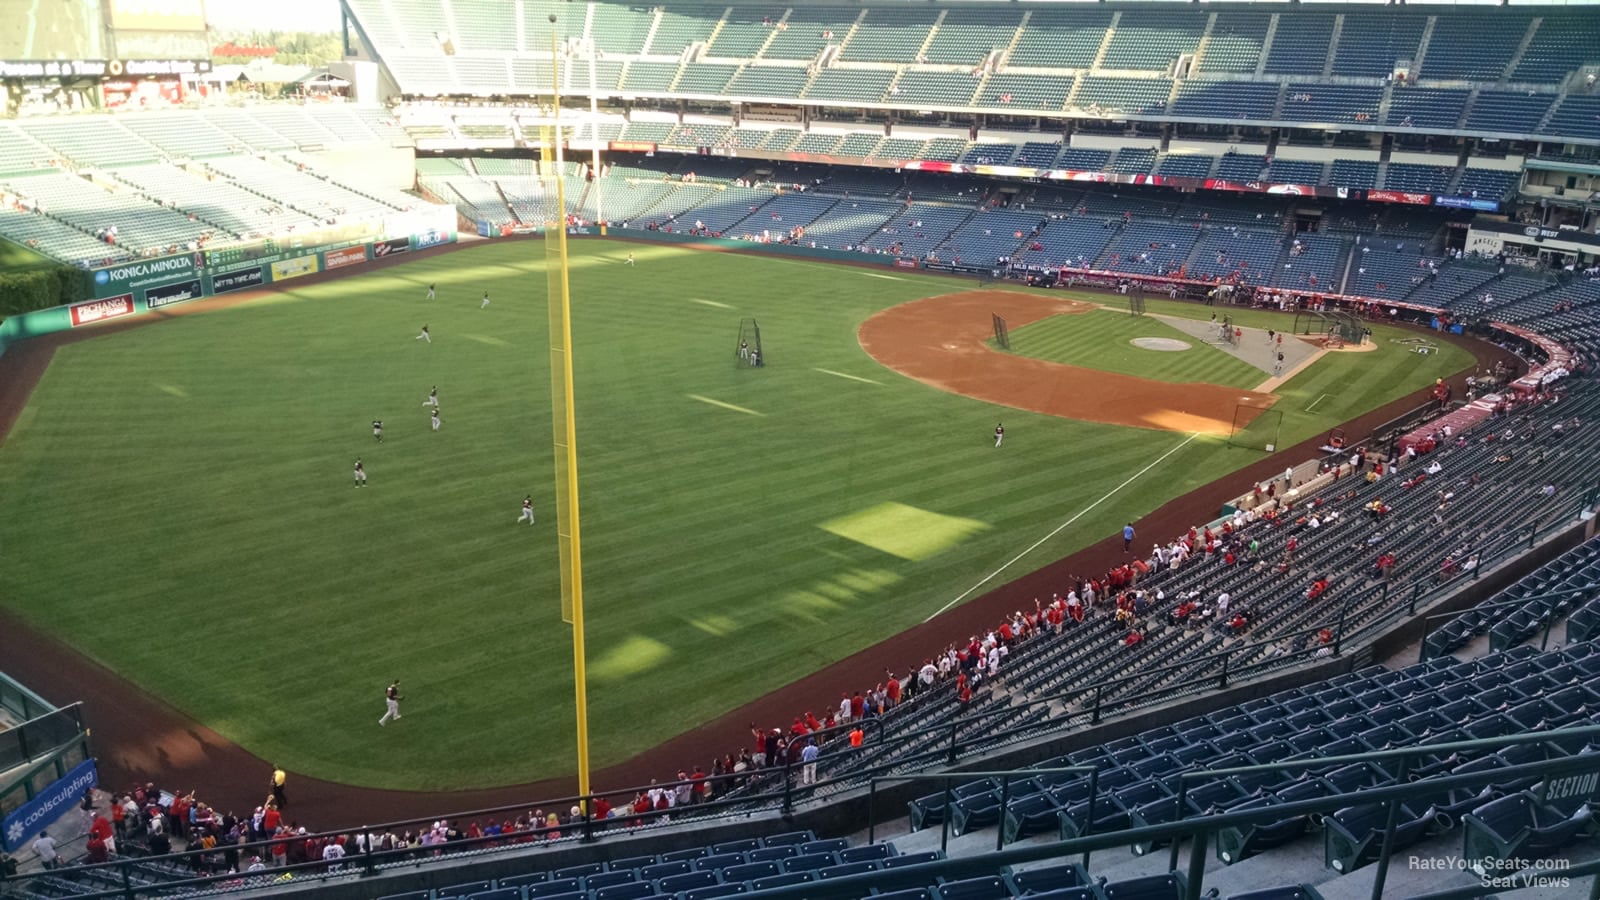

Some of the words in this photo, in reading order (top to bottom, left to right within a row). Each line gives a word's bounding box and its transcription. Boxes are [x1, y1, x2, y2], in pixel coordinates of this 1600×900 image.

[419, 233, 441, 246] ARCO
[1540, 229, 1559, 238] WEST
[110, 264, 149, 281] KONICA
[150, 257, 191, 273] MINOLTA
[214, 279, 233, 288] NITTO
[78, 298, 127, 315] PECHANGA
[148, 291, 192, 307] Thermador
[1547, 772, 1599, 800] SECTION
[25, 771, 93, 826] coolsculpting
